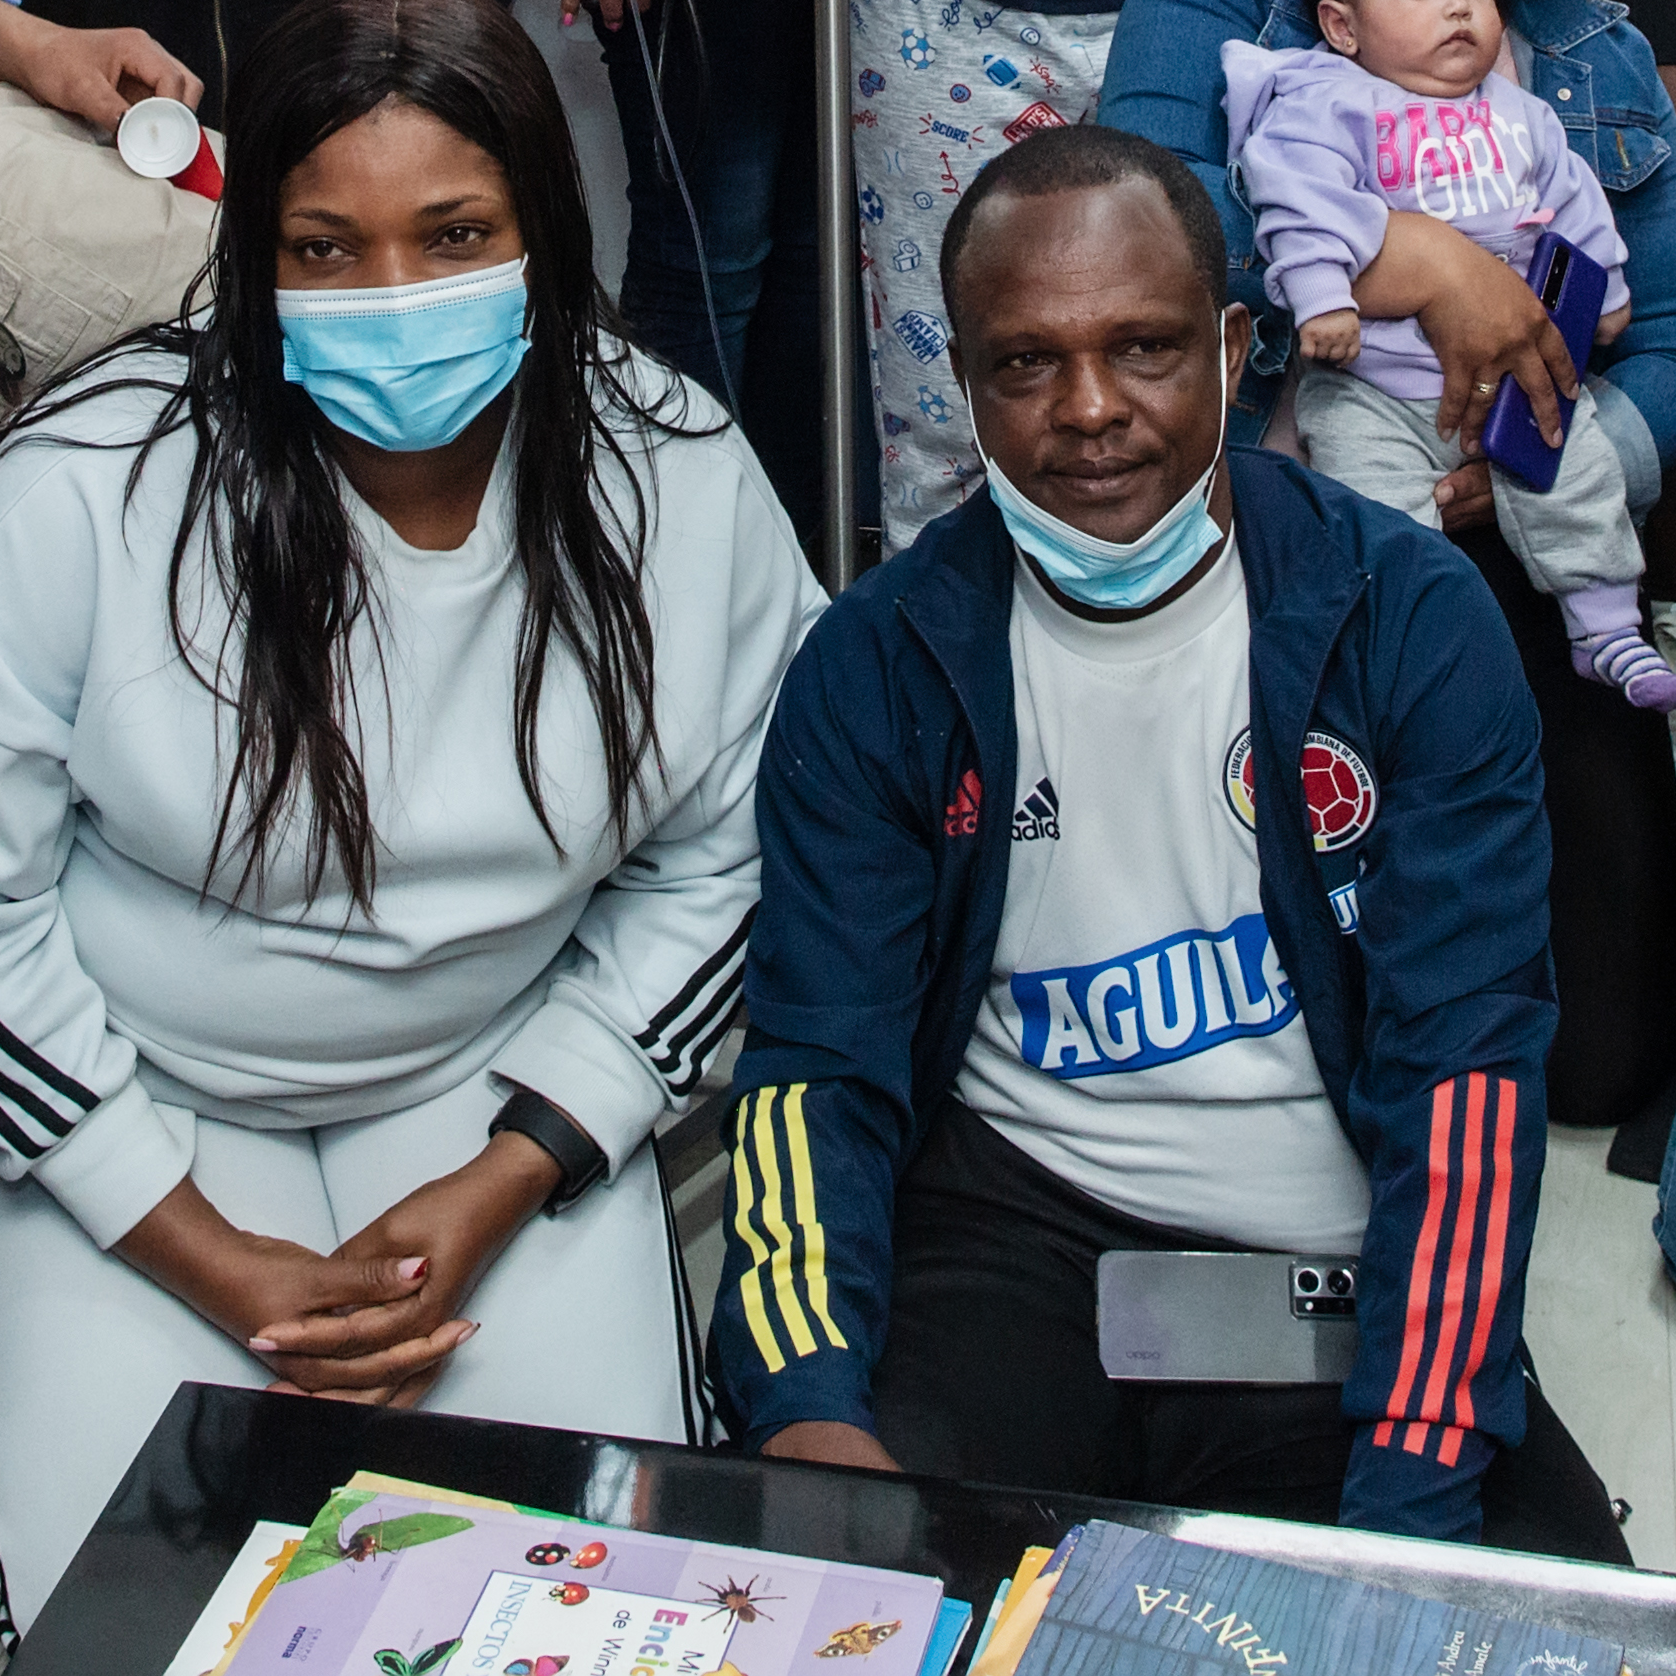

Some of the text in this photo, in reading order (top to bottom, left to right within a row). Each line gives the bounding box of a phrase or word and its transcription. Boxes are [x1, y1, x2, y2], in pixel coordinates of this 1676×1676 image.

[1375, 98, 1504, 192] BABY
[1340, 746, 1352, 760] DE
[472, 1579, 533, 1671] INSECTOS
[612, 1609, 632, 1629] de
[281, 1626, 307, 1659] norma
[1437, 1631, 1466, 1673] Andreu
[676, 1649, 706, 1675] Mi
